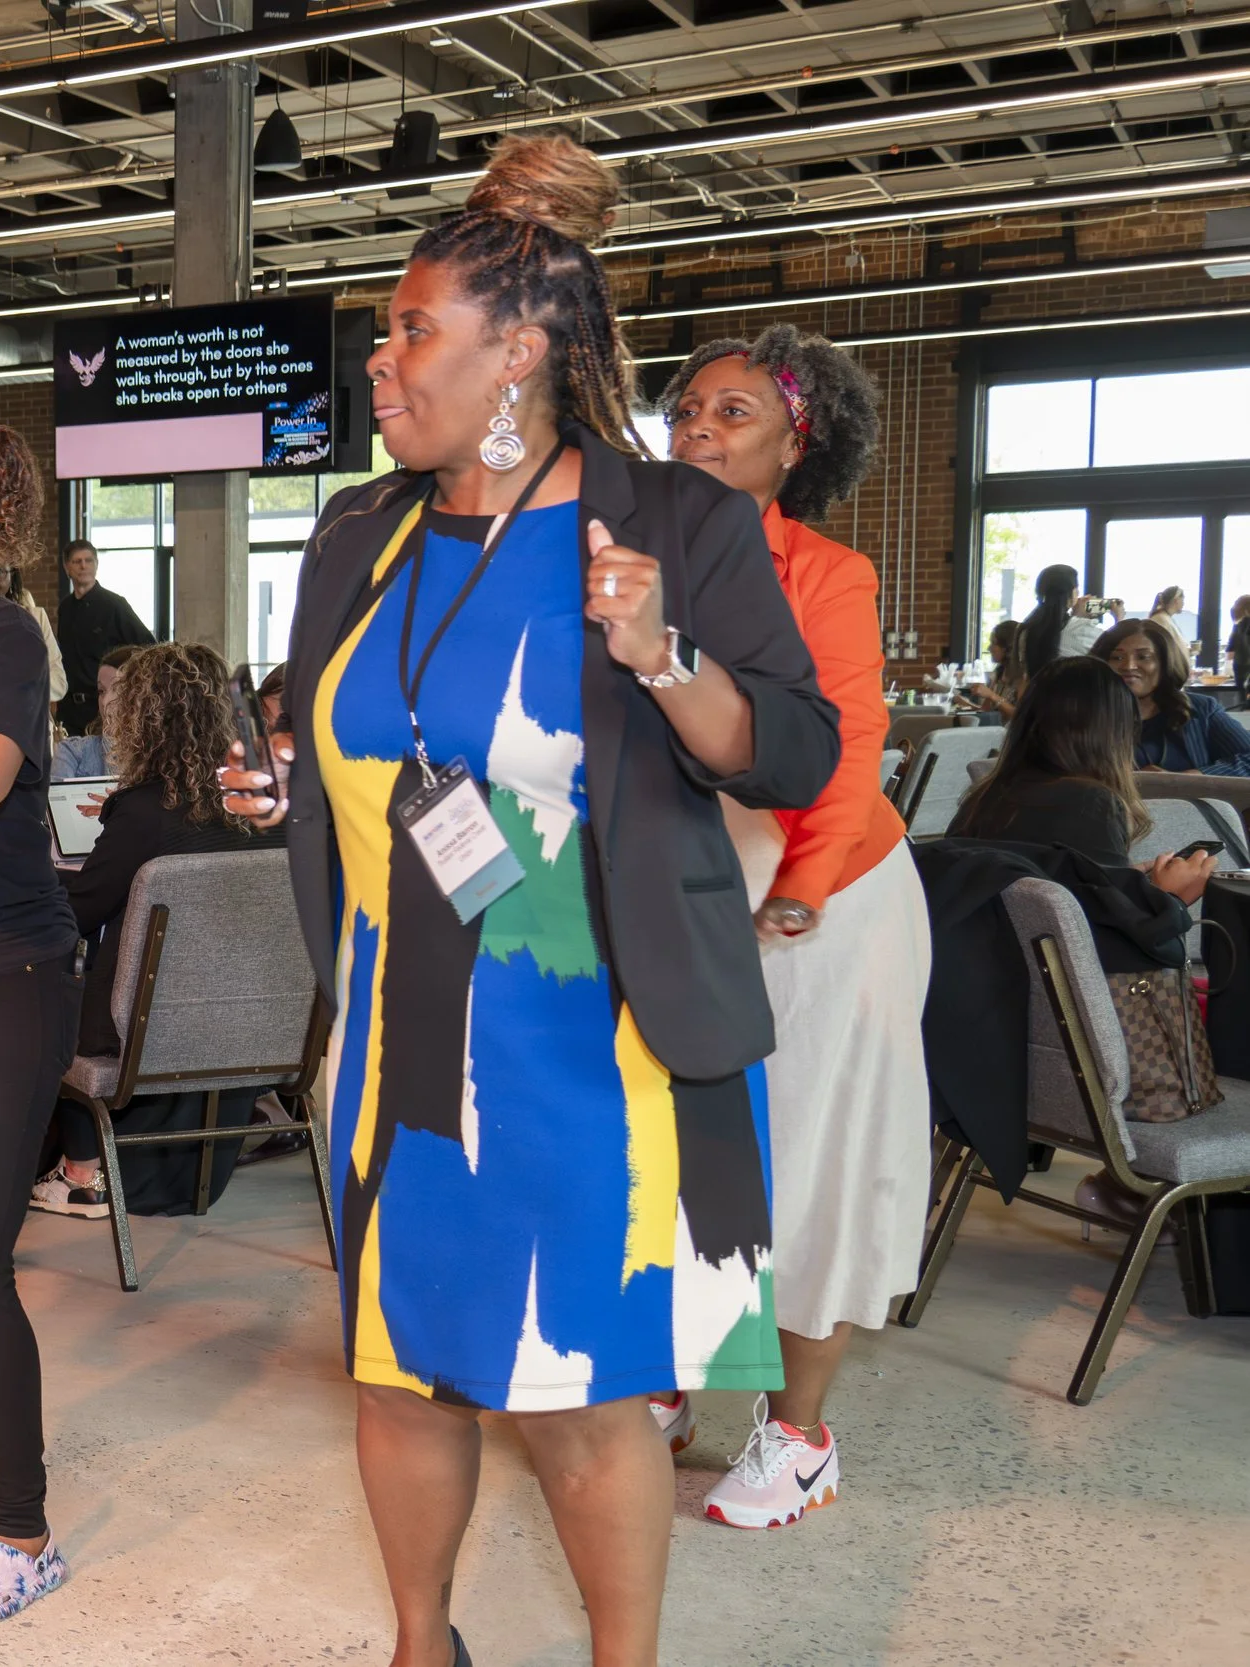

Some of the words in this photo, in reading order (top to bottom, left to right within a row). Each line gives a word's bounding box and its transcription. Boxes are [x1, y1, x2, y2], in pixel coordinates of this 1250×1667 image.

[115, 336, 126, 350] A
[129, 330, 185, 349] woman's
[187, 326, 225, 344] worth
[228, 327, 239, 341] is
[242, 324, 264, 339] not
[116, 349, 178, 368] measured
[182, 348, 198, 366] by
[200, 346, 222, 361] the
[225, 344, 263, 359] doors
[266, 340, 290, 356] she
[116, 371, 151, 387] walks
[154, 368, 207, 386] through,
[210, 364, 233, 380] but
[236, 362, 252, 381] by
[255, 360, 278, 376] the
[280, 360, 314, 374] ones
[116, 390, 138, 406] she
[141, 387, 184, 404] breaks
[186, 386, 220, 403] open
[223, 382, 243, 398] for
[245, 379, 288, 397] others
[274, 416, 305, 427] Power
[307, 414, 317, 425] In
